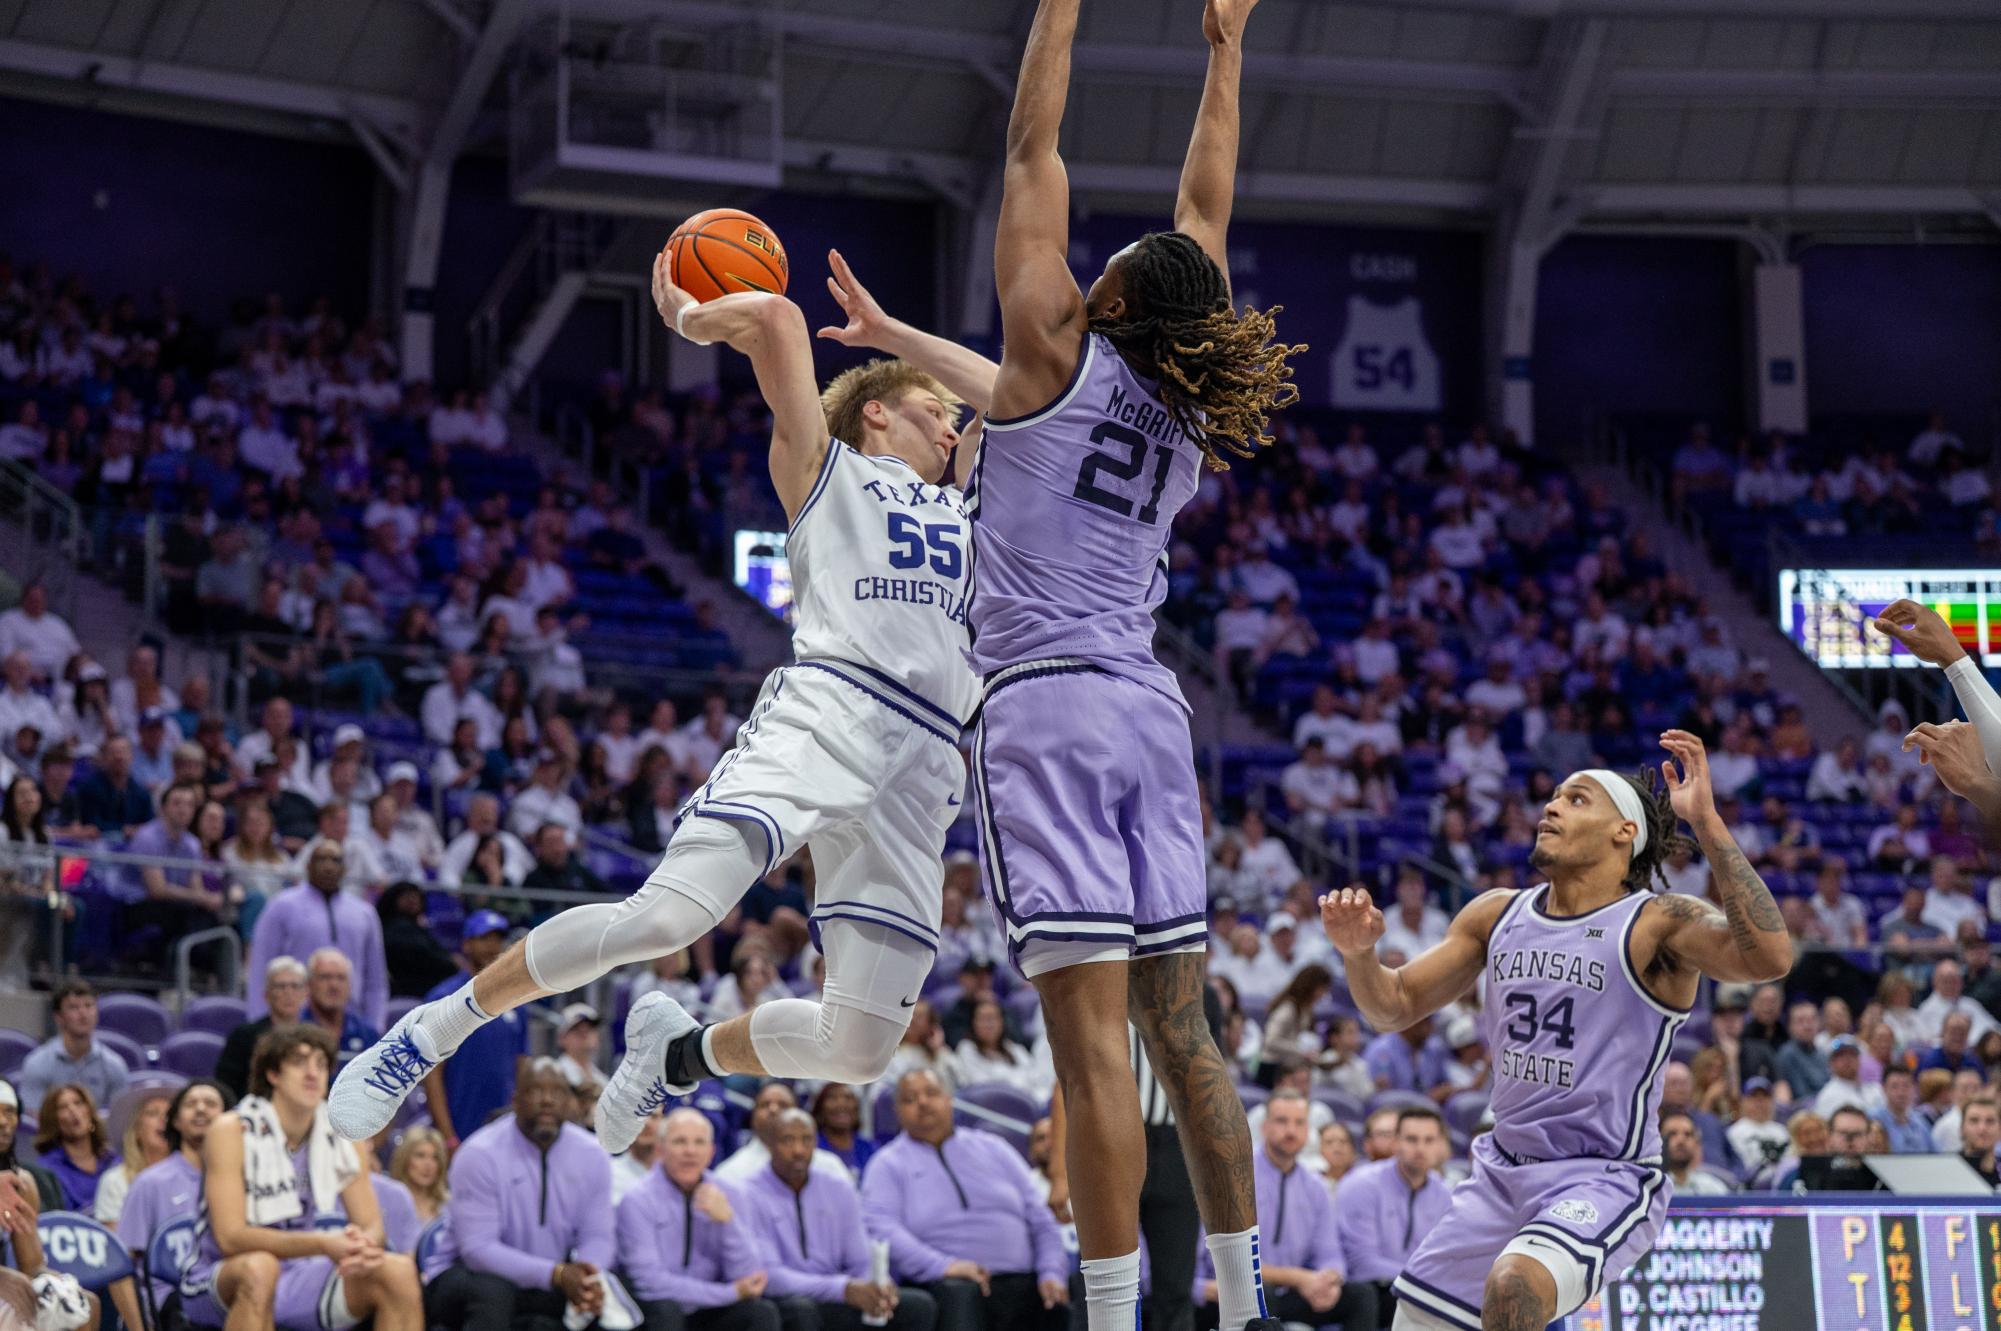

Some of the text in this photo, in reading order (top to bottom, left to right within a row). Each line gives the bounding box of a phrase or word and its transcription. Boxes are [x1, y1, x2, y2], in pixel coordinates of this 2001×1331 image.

[1354, 346, 1416, 392] 54
[1073, 421, 1174, 525] 21
[888, 512, 962, 580] 55
[855, 576, 966, 626] CHRISTIA
[1493, 951, 1606, 992] KANSAS
[1505, 993, 1575, 1050] 34
[1502, 1048, 1574, 1088] STATE
[1654, 1218, 1774, 1250] AGGERTY
[1644, 1251, 1764, 1281] JOHNSON
[1619, 1284, 1647, 1314] D.
[1650, 1282, 1765, 1313] CASTILLO
